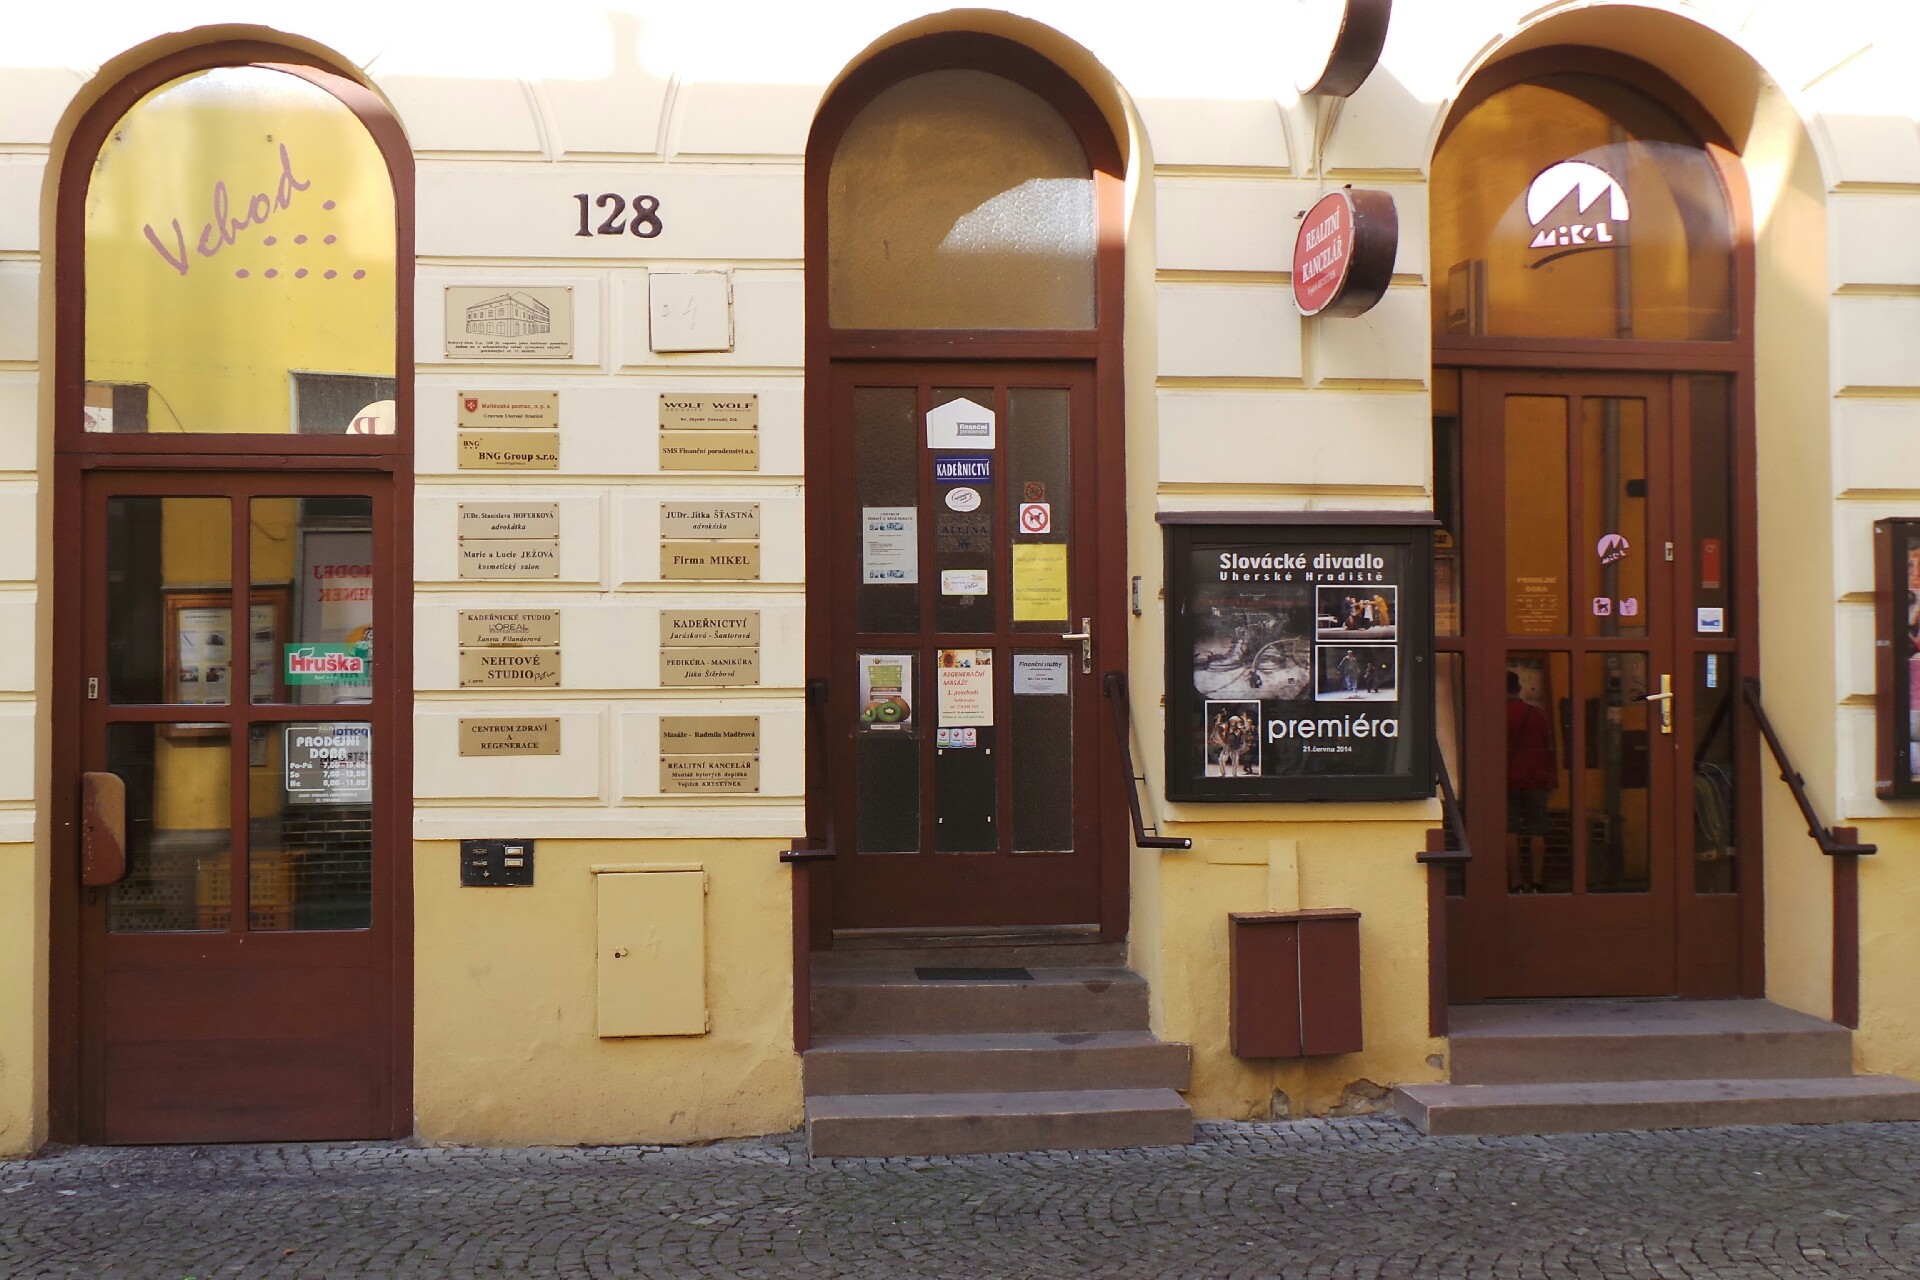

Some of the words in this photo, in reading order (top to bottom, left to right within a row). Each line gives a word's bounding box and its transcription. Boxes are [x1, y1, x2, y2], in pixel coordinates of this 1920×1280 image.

[143, 143, 310, 276] Vchod
[573, 193, 663, 238] 128
[1305, 204, 1340, 253] REALITNÍ
[1302, 235, 1342, 284] KANCELÁŘ
[479, 452, 501, 460] BNG
[504, 452, 533, 462] Group
[535, 453, 558, 461] s.r.o.
[936, 460, 990, 476] KADEŘNICTVÍ
[513, 510, 553, 519] HOFERKOVÁ
[665, 511, 690, 519] JUDr.
[690, 511, 710, 519] Jitka
[713, 510, 754, 519] ŠŤASTNÁ
[496, 550, 517, 558] Lucie
[520, 549, 553, 558] JEŽOVÁ
[673, 555, 705, 565] Firma
[710, 555, 750, 565] MIKEL
[1219, 553, 1306, 569] Slovácké
[1313, 553, 1384, 569] divadlo
[477, 563, 517, 571] kosmetický
[1219, 571, 1293, 581] Uherské
[1305, 571, 1383, 581] Hradiště
[467, 613, 519, 621] KADEŘNICKÉ
[673, 617, 748, 628] KADEŘNICTVÍ
[477, 634, 499, 642] Žaneta
[713, 630, 751, 639] Šantorová
[291, 654, 361, 672] Hruška
[481, 654, 541, 666] NEHTOVÉ
[666, 658, 705, 666] PEDIKÚRA
[487, 669, 534, 679] STUDIO
[704, 669, 735, 677] Štěrbová
[943, 670, 985, 678] REGENERAČNÍ
[471, 725, 514, 733] CENTRUM
[516, 723, 547, 732] ZDRAVÍ
[1268, 713, 1398, 743] premiéra
[309, 748, 347, 759] DOBA
[290, 761, 313, 769] Po-Pá
[667, 761, 705, 769] REALITNÍ
[708, 761, 751, 769] KANCELÁŘ
[290, 771, 300, 779] So
[323, 771, 340, 779] 7,00
[290, 780, 301, 788] Ne
